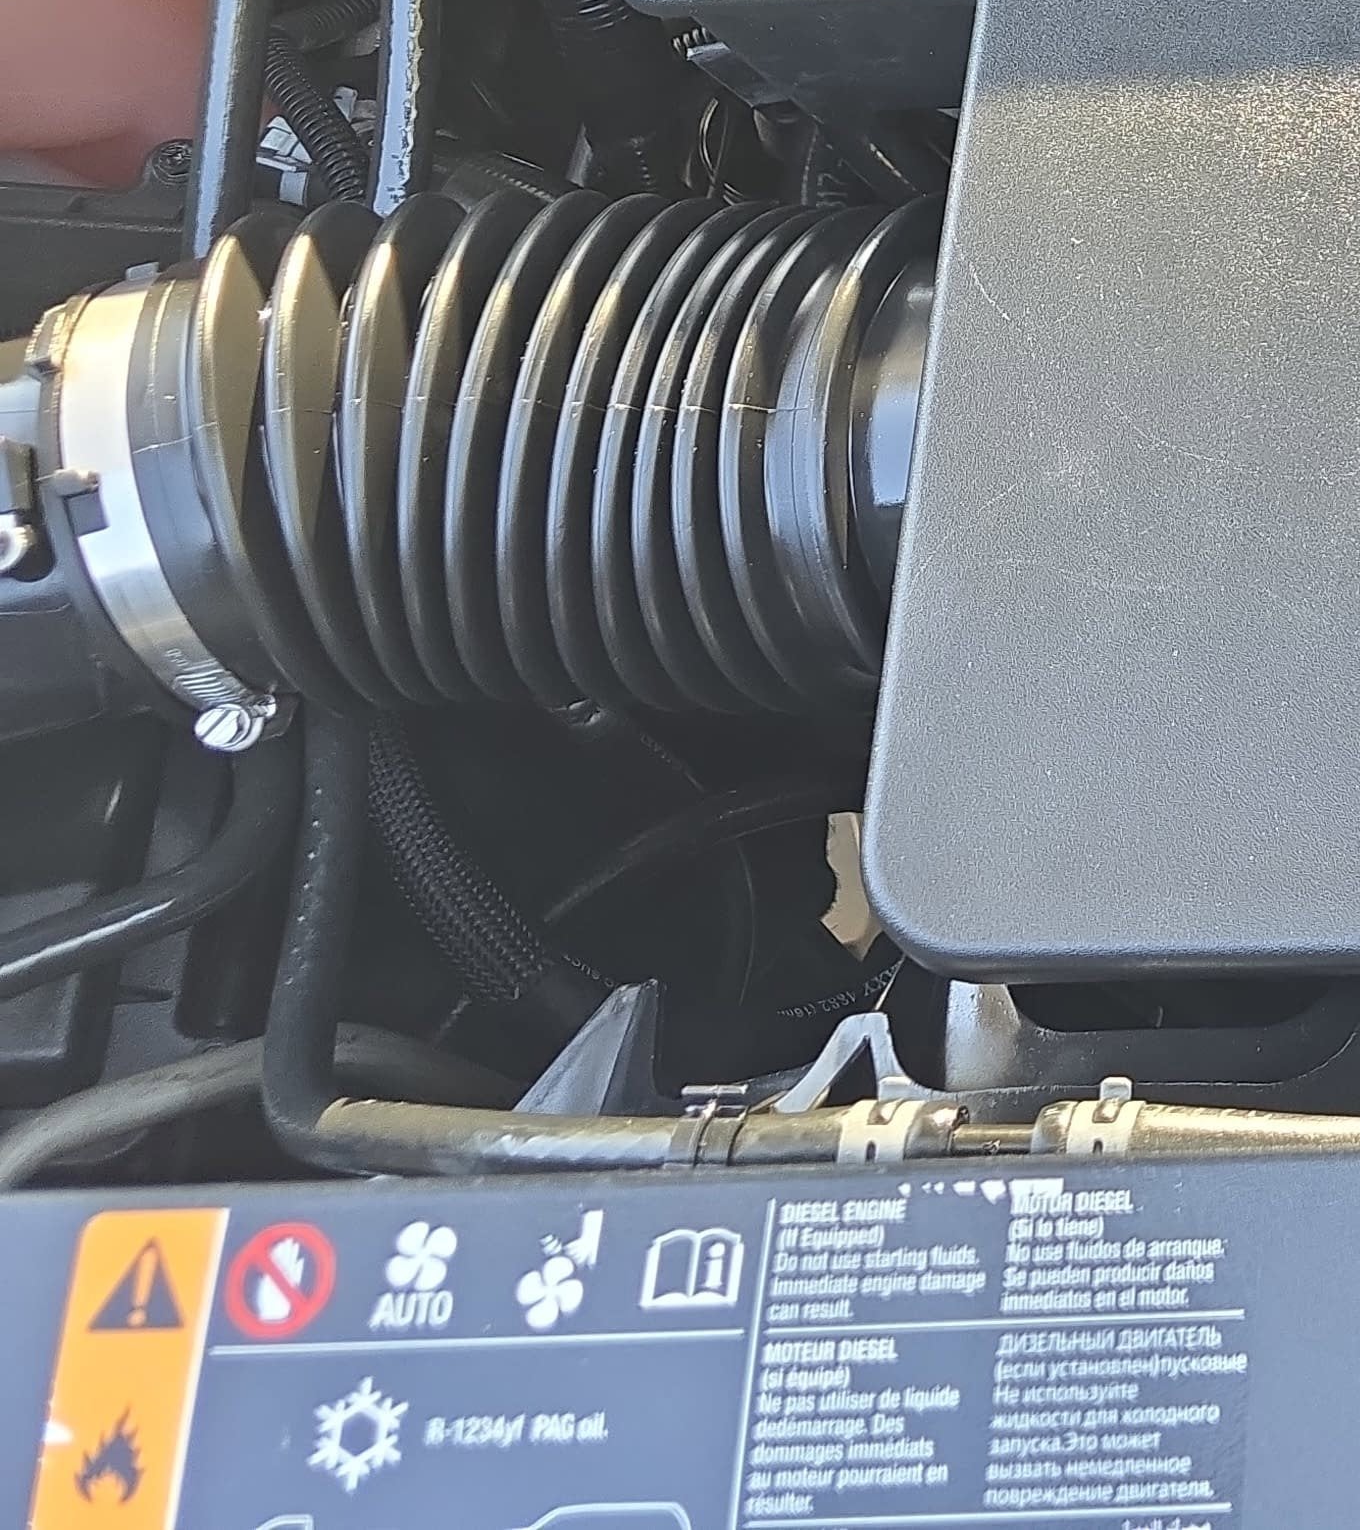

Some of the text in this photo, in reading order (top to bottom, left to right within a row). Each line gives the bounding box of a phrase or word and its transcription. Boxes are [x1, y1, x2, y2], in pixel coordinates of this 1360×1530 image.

[779, 1198, 907, 1224] DIESEL ENGINE
[1009, 1189, 1134, 1214] MOTOR DIESEL
[777, 1224, 885, 1250] (If Equipped)
[1008, 1216, 1104, 1241] (Si lo tiene)
[774, 1245, 980, 1273] Do not use starting fluids.
[1005, 1237, 1225, 1264] No use fluidos de arranque.
[771, 1271, 986, 1299] Immediate engine damage
[1002, 1260, 1214, 1289] Se pueden producir daños
[368, 1290, 453, 1330] AUTO
[767, 1299, 854, 1323] can result.
[1001, 1287, 1189, 1312] inmediatos en el motor.
[762, 1337, 898, 1364] MOTEUR DIESEL
[996, 1326, 1222, 1356] ДИЗЕЛЬНЫЙ ДВИГАТЕЛЬ
[761, 1366, 850, 1390] (si équipé)
[994, 1360, 1044, 1382] (если
[756, 1385, 960, 1415] Ne pas utiliser de liquide
[993, 1383, 1139, 1404] Не используйте
[529, 1412, 575, 1443] PAG
[575, 1411, 609, 1442] oil.
[870, 1414, 904, 1436] Des
[989, 1404, 1220, 1429] жидкости для холодного
[750, 1438, 934, 1466] dommages immédiats
[1100, 1432, 1161, 1452] может
[747, 1464, 948, 1491] au moteur pourraient en
[986, 1456, 1192, 1482] вызвать немедленное
[745, 1493, 814, 1516] résulter.
[984, 1479, 1214, 1508] повреждение двигателя.
